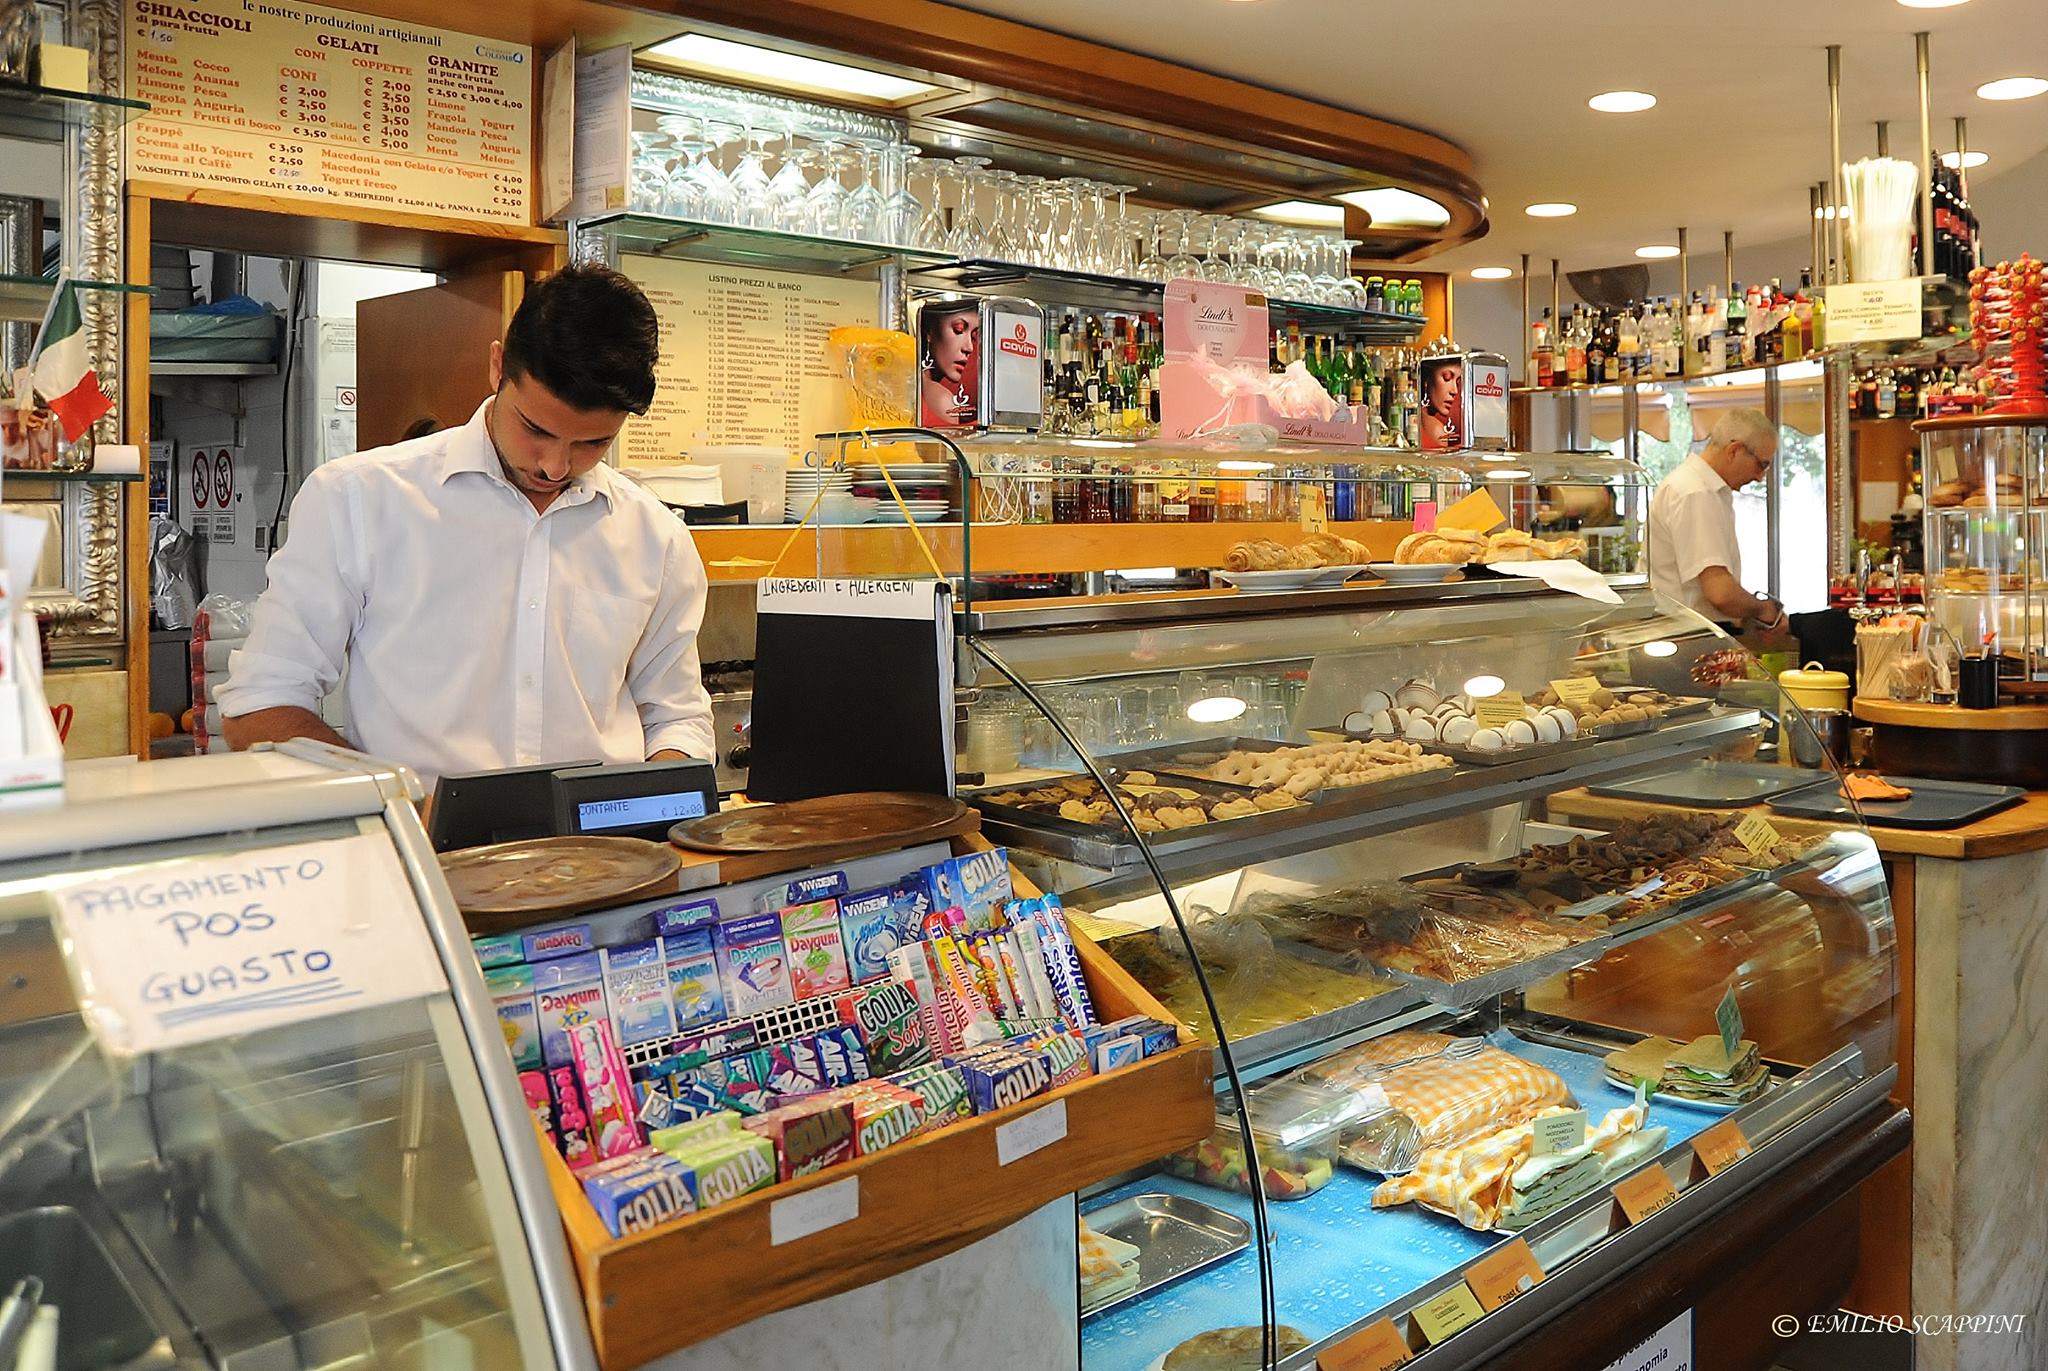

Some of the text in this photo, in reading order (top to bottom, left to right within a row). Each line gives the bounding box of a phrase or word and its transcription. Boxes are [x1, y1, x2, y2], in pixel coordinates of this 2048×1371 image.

[136, 1, 252, 32] GHIACCIOLI
[136, 15, 219, 36] di pura frutta
[259, 4, 300, 20] nostre
[305, 12, 374, 35] produzioni
[378, 29, 441, 47] artigianali
[316, 34, 379, 55] GELATI
[137, 49, 178, 64] Menta
[294, 48, 326, 61] CONI
[137, 63, 184, 78] Melone
[193, 59, 230, 73] Cocco
[280, 67, 317, 81] CONI
[352, 58, 413, 76] COPPETTE
[428, 55, 499, 77] GRANITE
[137, 76, 186, 92] Limone
[193, 72, 240, 88] Ananas
[440, 70, 462, 79] pura
[465, 73, 493, 85] frutta
[193, 85, 228, 98] Pesca
[298, 87, 327, 98] 2,00
[382, 80, 411, 92] 2,00
[428, 77, 504, 96] anche con panna
[136, 89, 187, 105] Fragola
[298, 99, 326, 111] 2,50
[382, 91, 410, 103] 2,50
[427, 98, 466, 111] Limone
[193, 98, 245, 113] Anguria
[381, 102, 410, 114] 3,00
[193, 111, 281, 131] Frutti di bosco
[298, 112, 326, 123] 3,00
[381, 114, 409, 126] 3,50
[427, 110, 467, 123] Fragola
[302, 128, 327, 138] 3,50
[381, 126, 409, 138] 4,00
[427, 121, 476, 136] Mandorla
[481, 119, 515, 131] Yogurt
[427, 133, 457, 145] Cocco
[480, 130, 508, 141] Pesca
[136, 136, 254, 159] Crema allo Yogurt
[380, 138, 409, 150] 5,00
[426, 145, 459, 157] Menta
[480, 142, 521, 155] Anguria
[136, 149, 179, 163] Crema
[183, 155, 194, 165] al
[321, 149, 380, 165] Macedonia
[383, 158, 401, 167] con
[404, 160, 436, 172] Gelato
[455, 167, 488, 179] Yogurt
[480, 153, 515, 165] Melone
[321, 161, 380, 177] Macedonia
[136, 165, 191, 178] VASCHETTE
[192, 171, 206, 180] DA
[253, 180, 285, 189] GELATI
[295, 184, 324, 193] 20,00
[344, 190, 394, 203] SEMIFREDDI
[322, 173, 397, 191] Yogurt fresco
[708, 275, 802, 291] LISTINO PREZZI AL BANCO
[1199, 305, 1227, 320] Lindt
[1002, 340, 1037, 356] covim
[1476, 387, 1502, 395] covim
[1283, 422, 1307, 437] Lindt
[763, 579, 826, 597] INGREDIENTI
[849, 580, 915, 597] ALLERGENI
[580, 801, 629, 816] CONTANTE
[69, 858, 324, 919] PAGAMENTO
[666, 905, 712, 926] Daygum
[158, 903, 275, 946] POS
[790, 932, 839, 954] Daygum
[730, 941, 781, 967] Daygum
[141, 949, 331, 1003] GUASTO
[668, 962, 712, 983] aygum
[541, 988, 600, 1013] Daygum
[561, 1010, 589, 1028] XP
[888, 1015, 924, 1056] Soft
[700, 1034, 727, 1057] AIR
[818, 1038, 848, 1080] AIR
[850, 1049, 870, 1080] AIR
[1498, 1289, 1517, 1304] Toast
